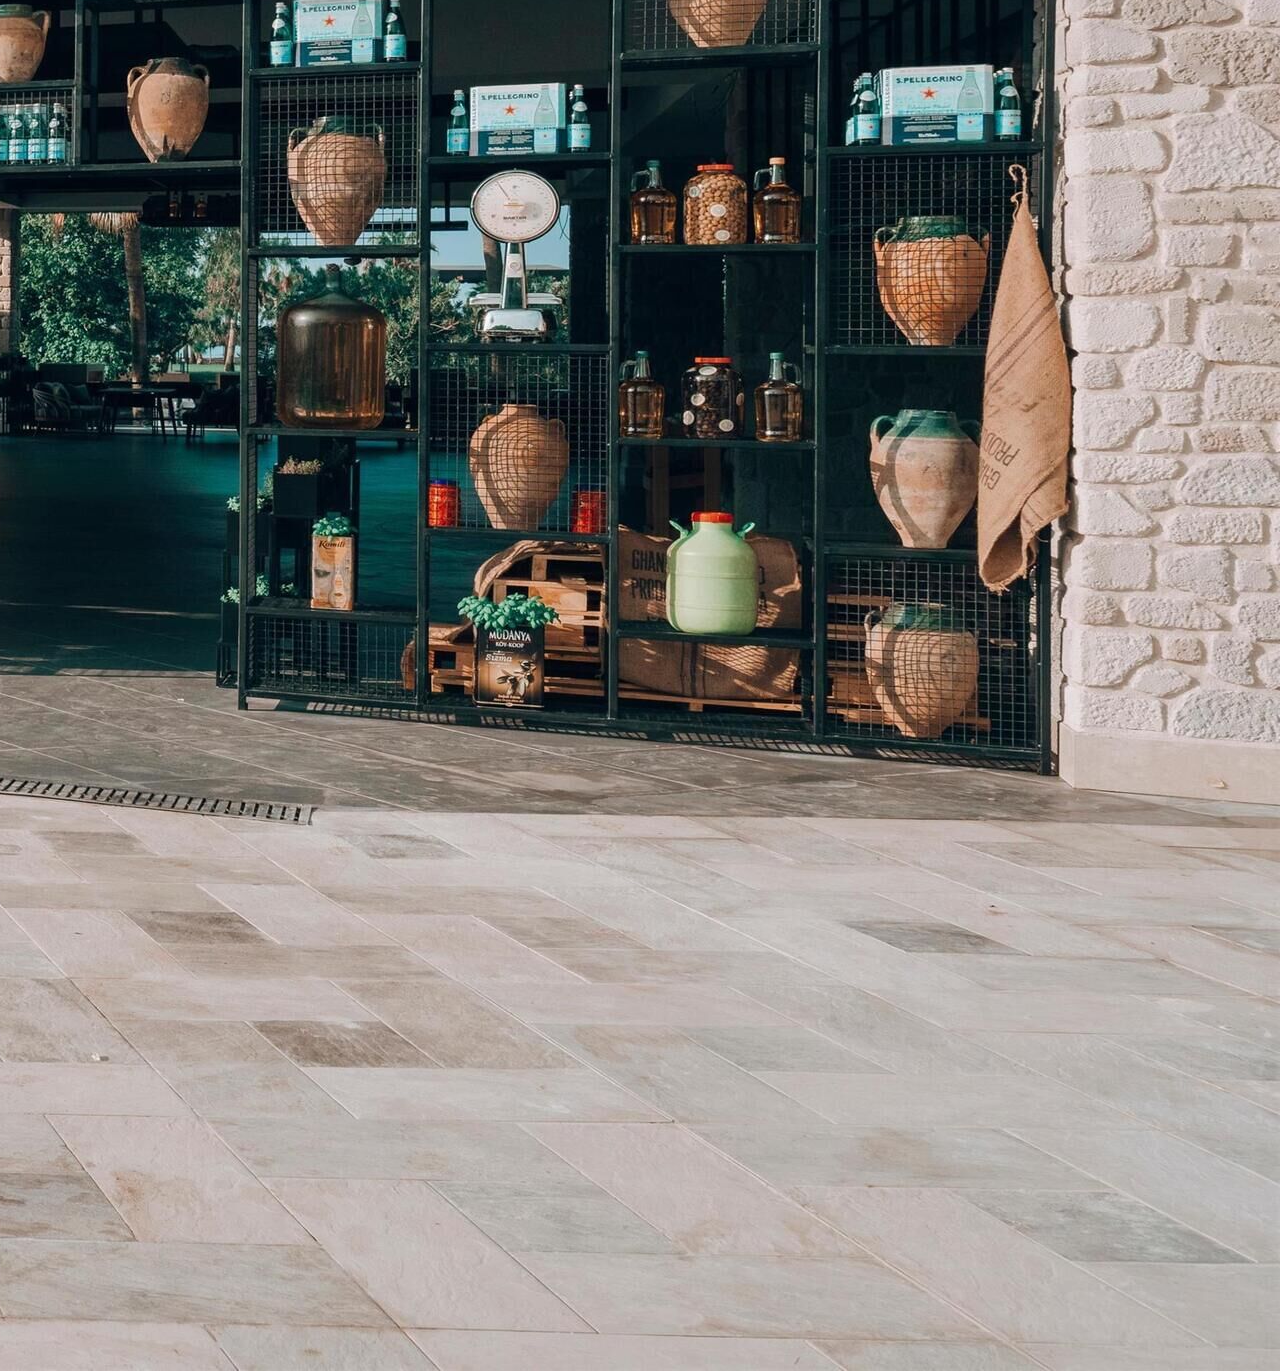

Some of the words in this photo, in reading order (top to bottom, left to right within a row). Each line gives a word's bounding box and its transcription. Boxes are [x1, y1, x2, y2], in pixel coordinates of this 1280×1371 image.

[302, 4, 357, 13] S.PELLEGRINO
[895, 74, 964, 84] S.PELLEGRINO
[481, 93, 540, 101] S.PELLEGRINO
[488, 629, 531, 642] MUDANYA
